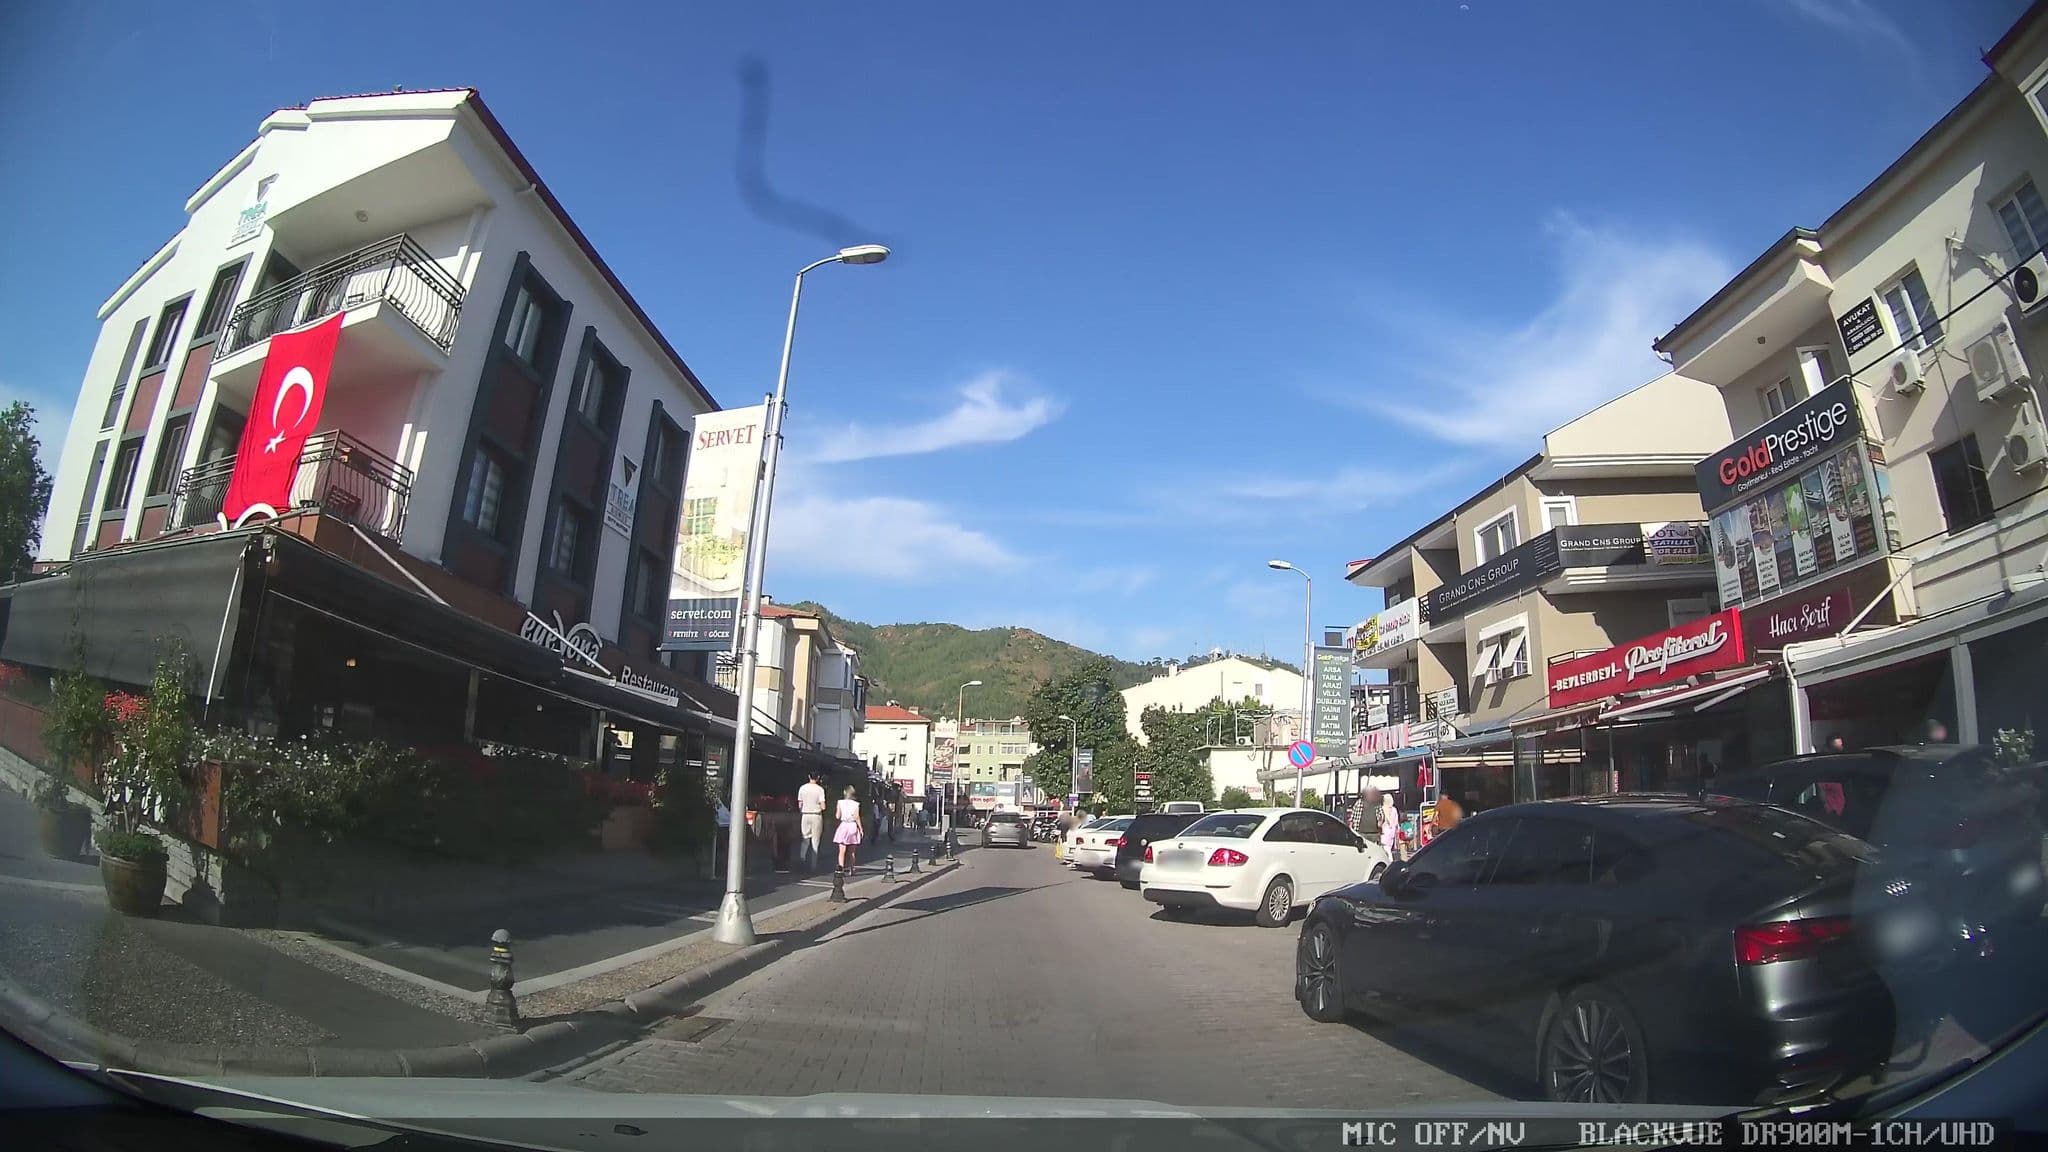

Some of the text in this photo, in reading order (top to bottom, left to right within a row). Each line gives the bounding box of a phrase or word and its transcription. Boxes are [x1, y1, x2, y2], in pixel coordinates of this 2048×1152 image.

[1843, 303, 1871, 327] AVUKAT
[696, 424, 756, 450] SERVET
[1719, 402, 1847, 486] GoldPrestige
[1771, 463, 1783, 475] Real
[1783, 456, 1799, 469] Estate
[1802, 445, 1818, 459] Yacht
[1560, 540, 1590, 548] GRAND
[1612, 537, 1640, 545] GROUP
[1439, 584, 1467, 604] GRAND
[1467, 574, 1486, 590] CNS
[1487, 558, 1519, 581] GROUP
[670, 608, 732, 620] servet.com
[1769, 596, 1831, 638] Hacı Şerif
[1625, 620, 1727, 682] Profiterol
